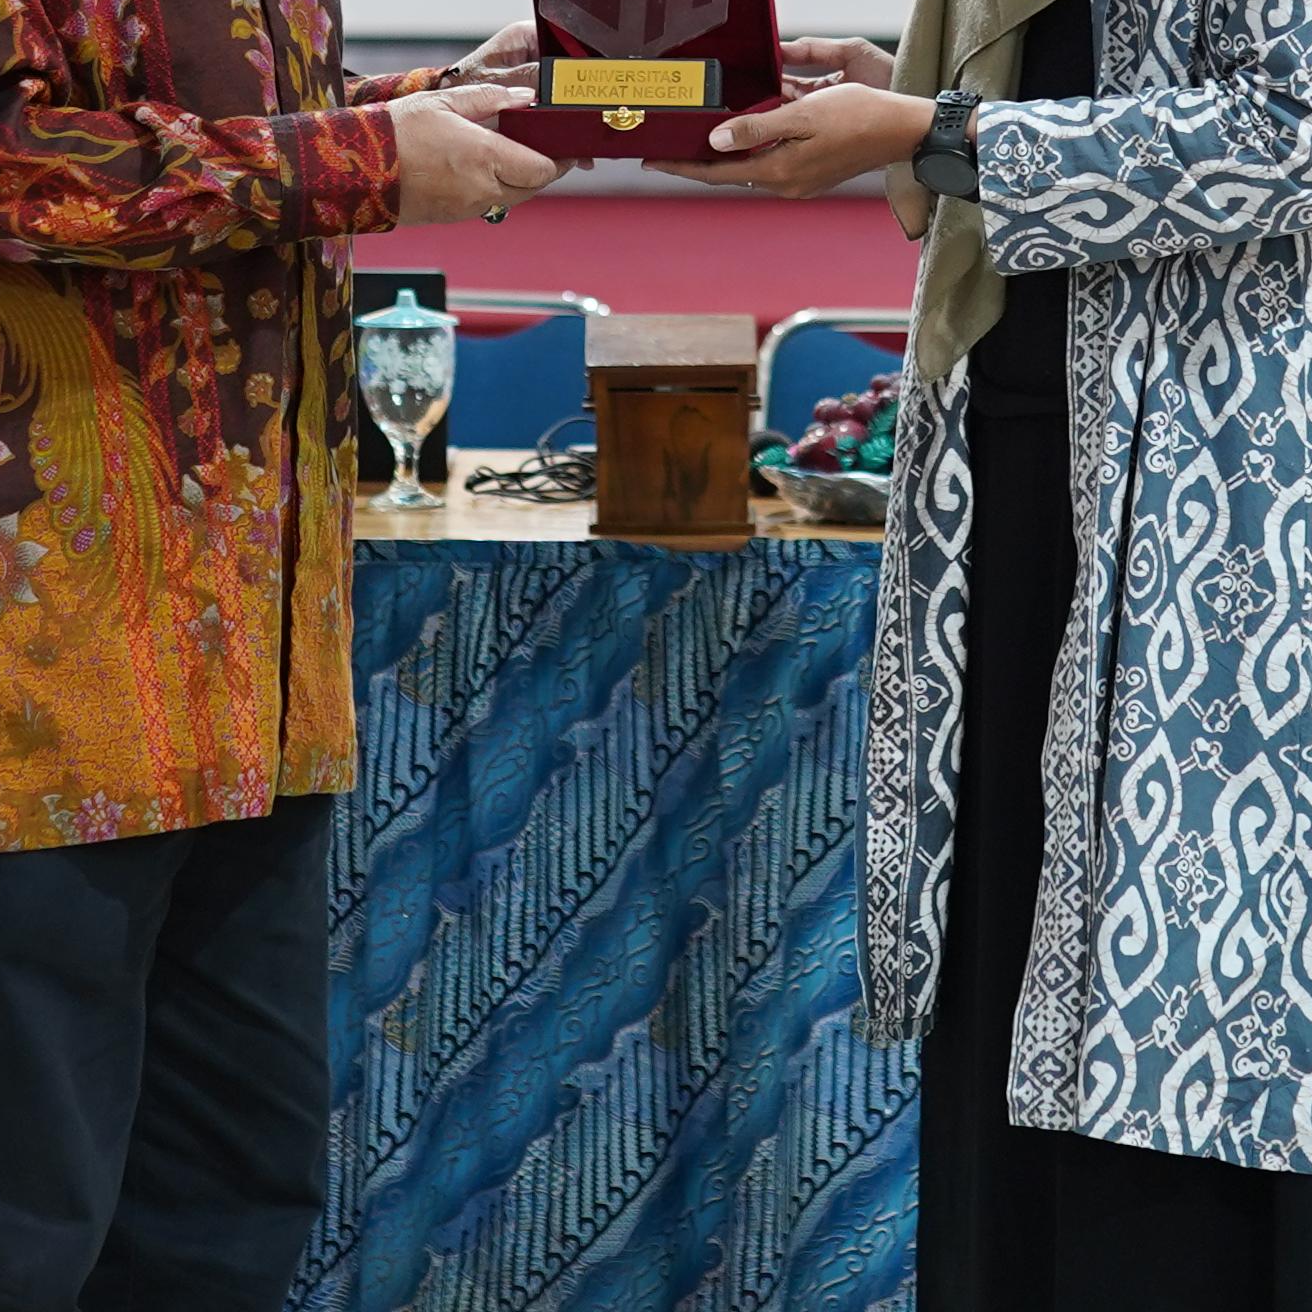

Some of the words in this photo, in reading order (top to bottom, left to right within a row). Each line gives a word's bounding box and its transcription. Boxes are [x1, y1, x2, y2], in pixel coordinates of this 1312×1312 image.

[576, 69, 681, 83] UNIVERSITAS
[563, 85, 628, 98] HARKAT
[632, 86, 693, 99] NEGERI
